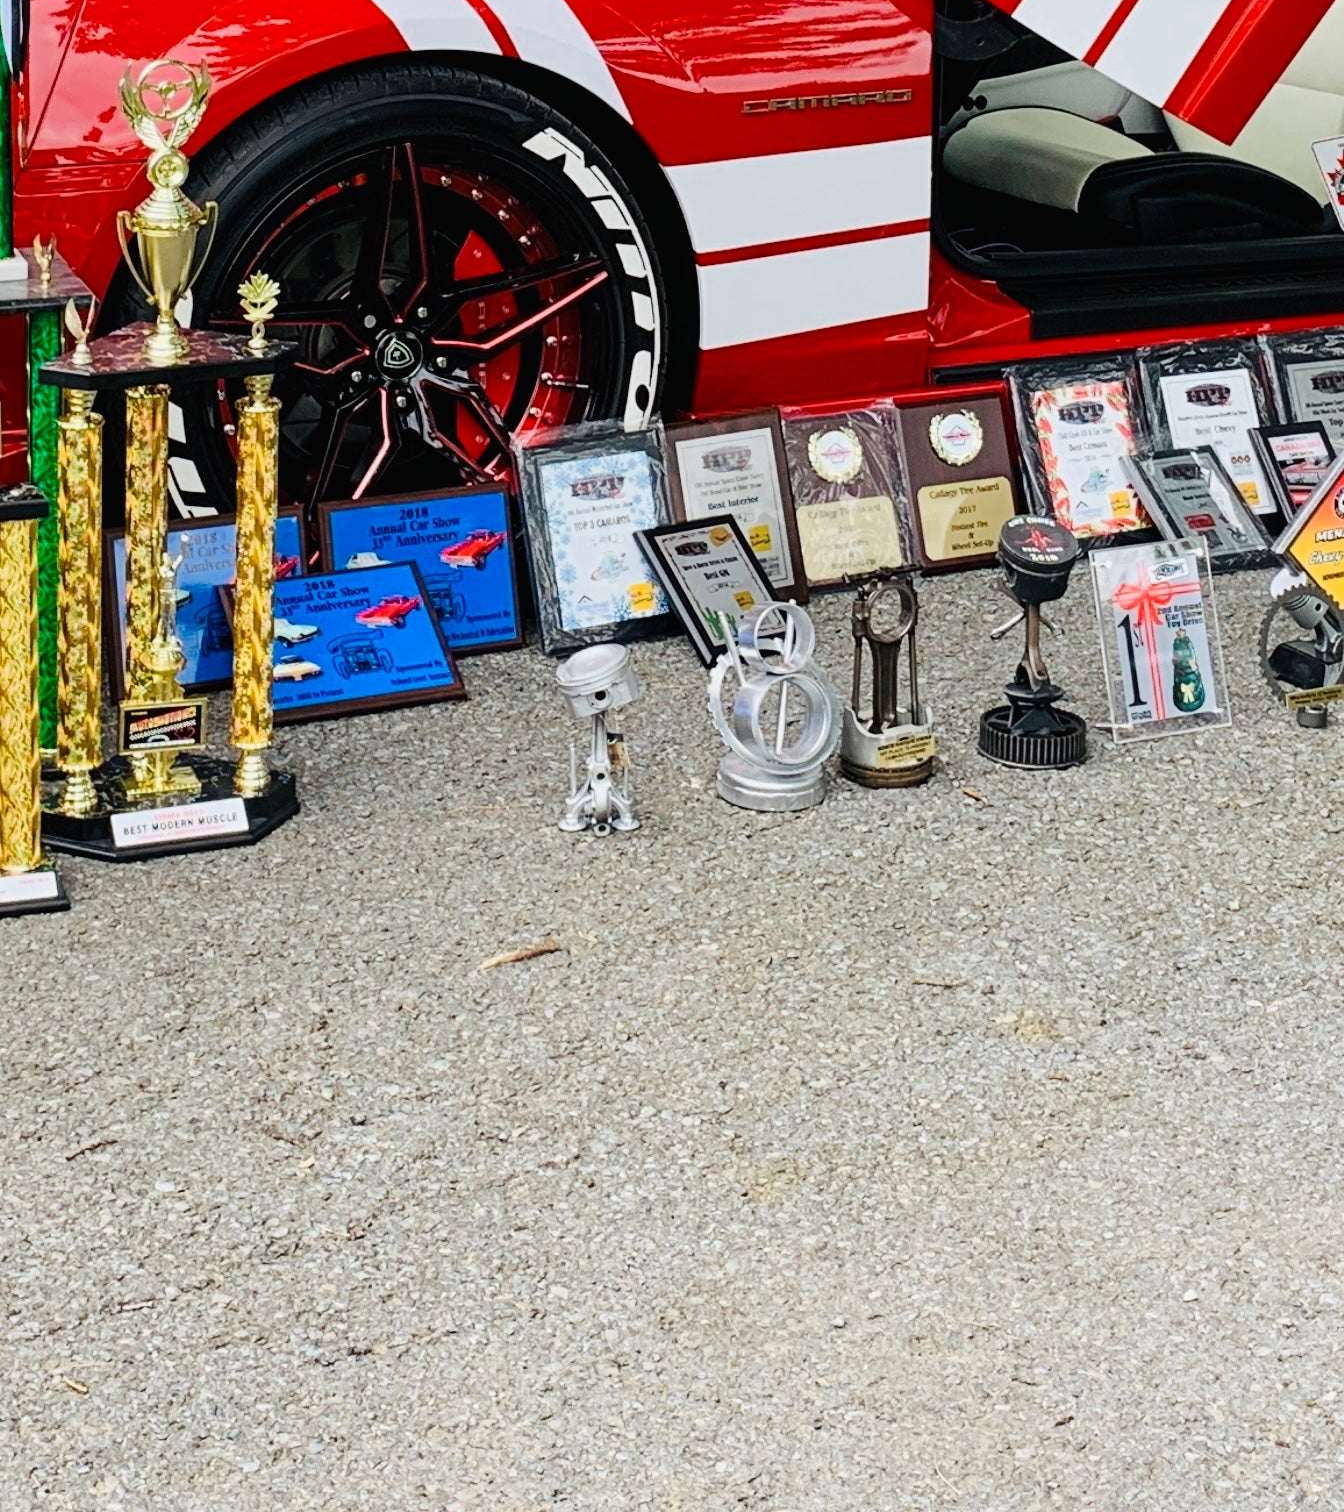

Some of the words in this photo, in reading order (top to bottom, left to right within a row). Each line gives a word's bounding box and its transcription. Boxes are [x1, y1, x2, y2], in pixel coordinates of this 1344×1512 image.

[742, 89, 912, 114] CAMARO
[1328, 417, 1344, 427] Top
[1069, 444, 1082, 452] Best
[976, 482, 1000, 493] Award
[708, 500, 726, 511] Best
[399, 506, 429, 520] 2018
[368, 523, 406, 537] Annual
[409, 518, 429, 532] Car
[432, 516, 460, 529] Show
[574, 519, 587, 531] TOP
[395, 530, 459, 548] Anniversary
[952, 541, 972, 550] Wheel
[197, 546, 218, 558] Car
[1309, 548, 1344, 566] Chevy
[303, 579, 336, 592] 2018
[276, 590, 315, 606] Annual
[317, 589, 338, 601] Car
[340, 586, 370, 598] Show
[306, 597, 371, 615] Anniversary
[1165, 614, 1180, 622] Car
[1168, 620, 1181, 628] Toy
[124, 824, 148, 835] BEST
[151, 819, 194, 831] MODERN
[198, 812, 237, 824] MUSCLE
